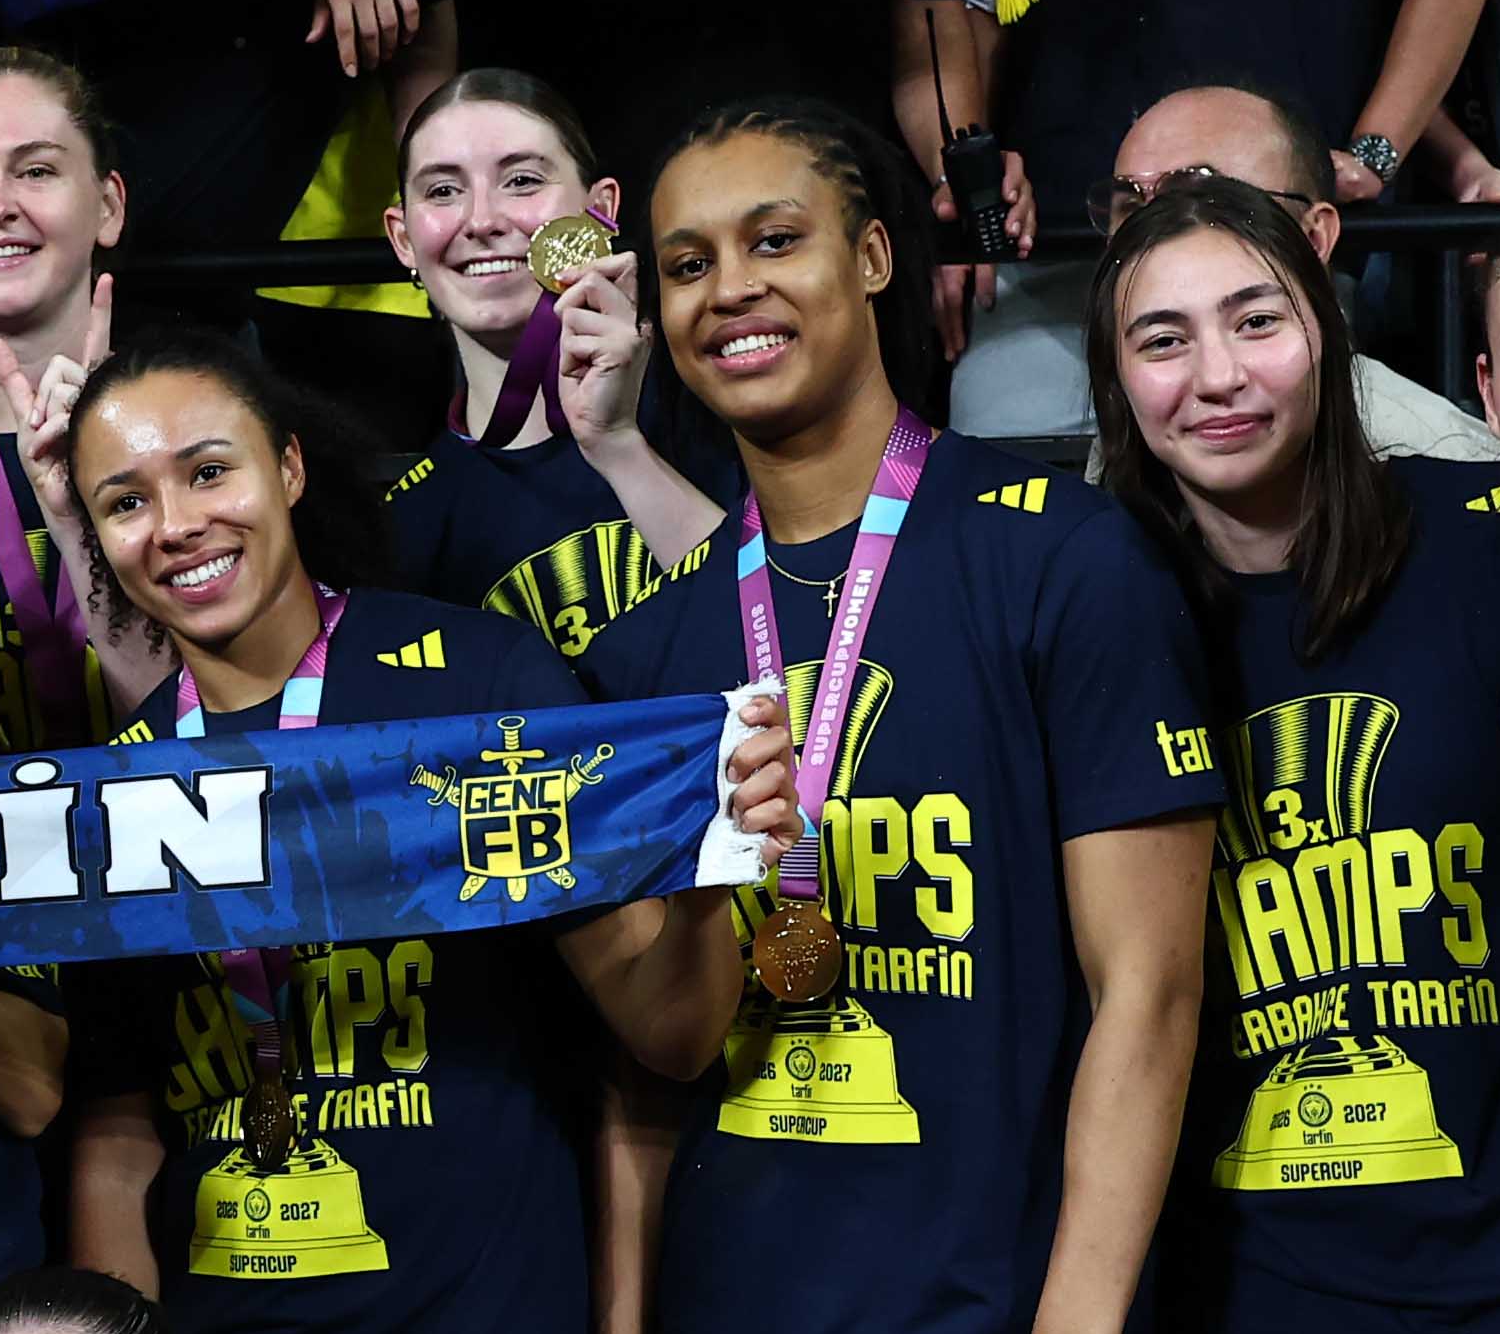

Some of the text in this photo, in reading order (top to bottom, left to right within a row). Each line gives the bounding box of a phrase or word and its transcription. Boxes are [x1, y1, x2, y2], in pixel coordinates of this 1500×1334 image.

[552, 604, 597, 659] 3
[1155, 719, 1216, 778] tar
[469, 810, 567, 873] FB
[1212, 823, 1491, 1000] AMPS
[818, 1063, 852, 1083] 2027
[768, 1113, 828, 1136] SUPERCUP
[1343, 1102, 1387, 1125] 2027
[1303, 1129, 1334, 1145] tarfin
[1280, 1160, 1364, 1183] SUPERCUP
[280, 1201, 320, 1221] 2027
[229, 1254, 298, 1274] SUPERCUP
